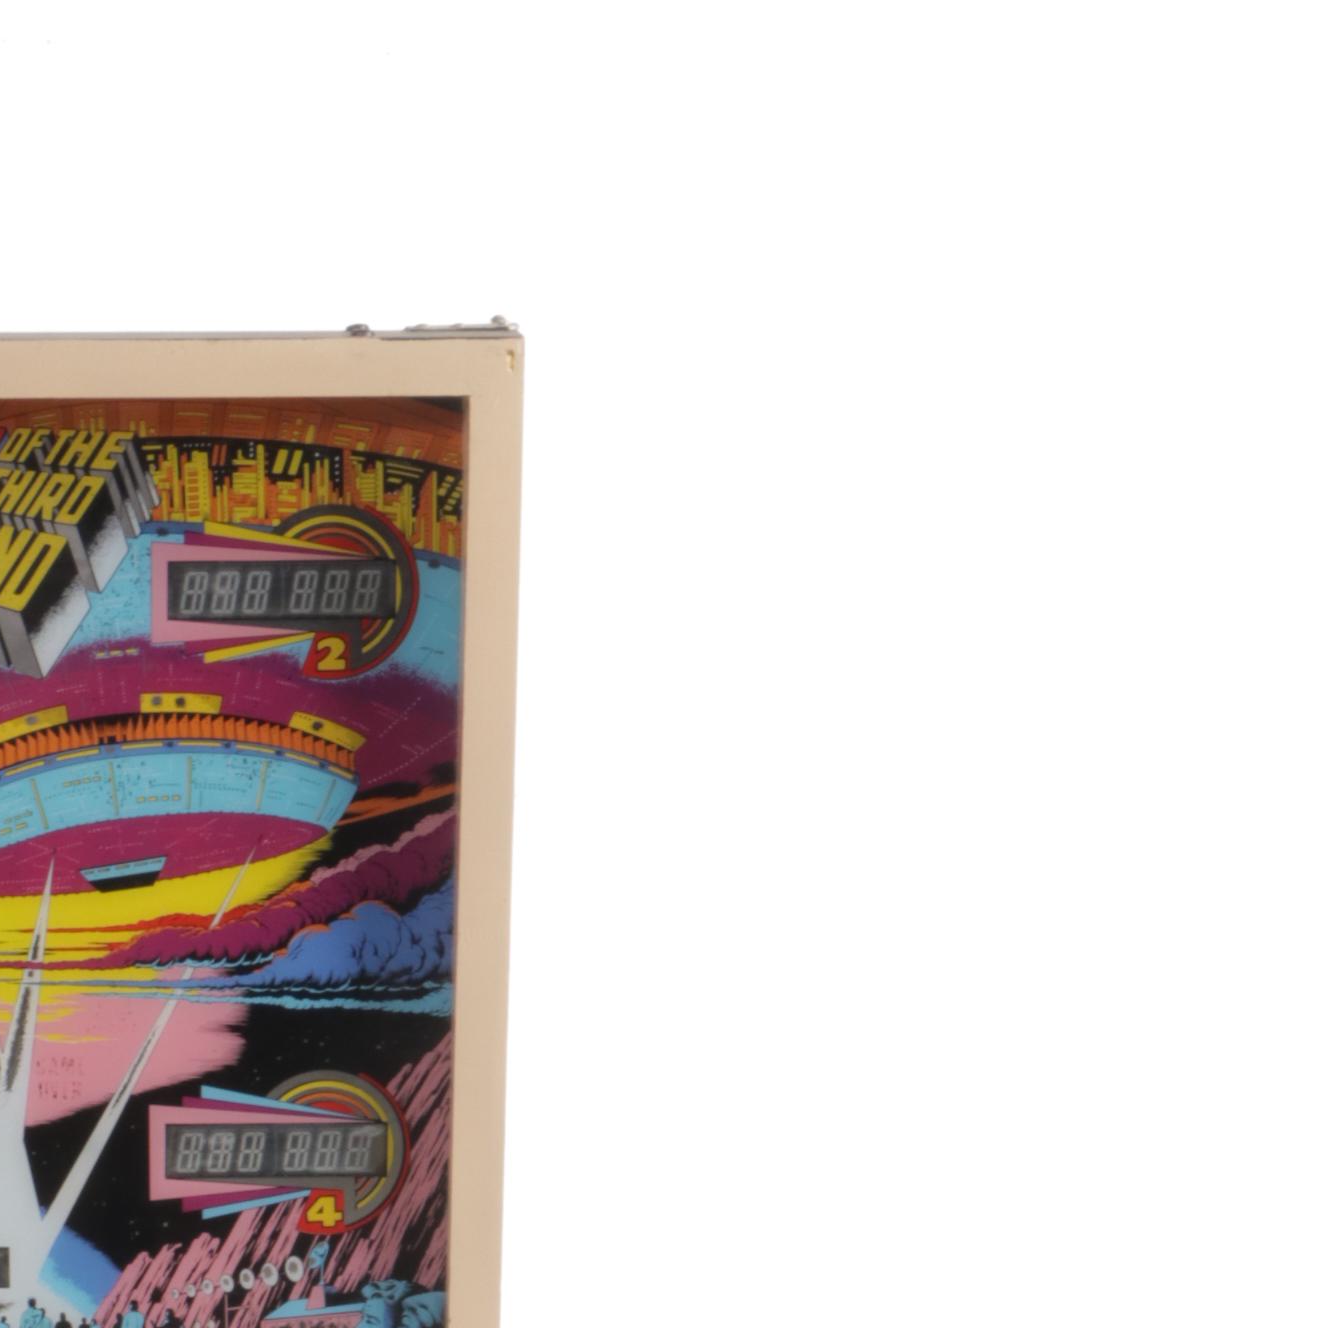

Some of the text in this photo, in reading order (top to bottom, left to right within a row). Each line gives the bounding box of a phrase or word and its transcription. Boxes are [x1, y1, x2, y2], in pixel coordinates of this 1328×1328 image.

[44, 429, 134, 470] THE
[316, 636, 346, 671] 2
[306, 1196, 343, 1228] 4
